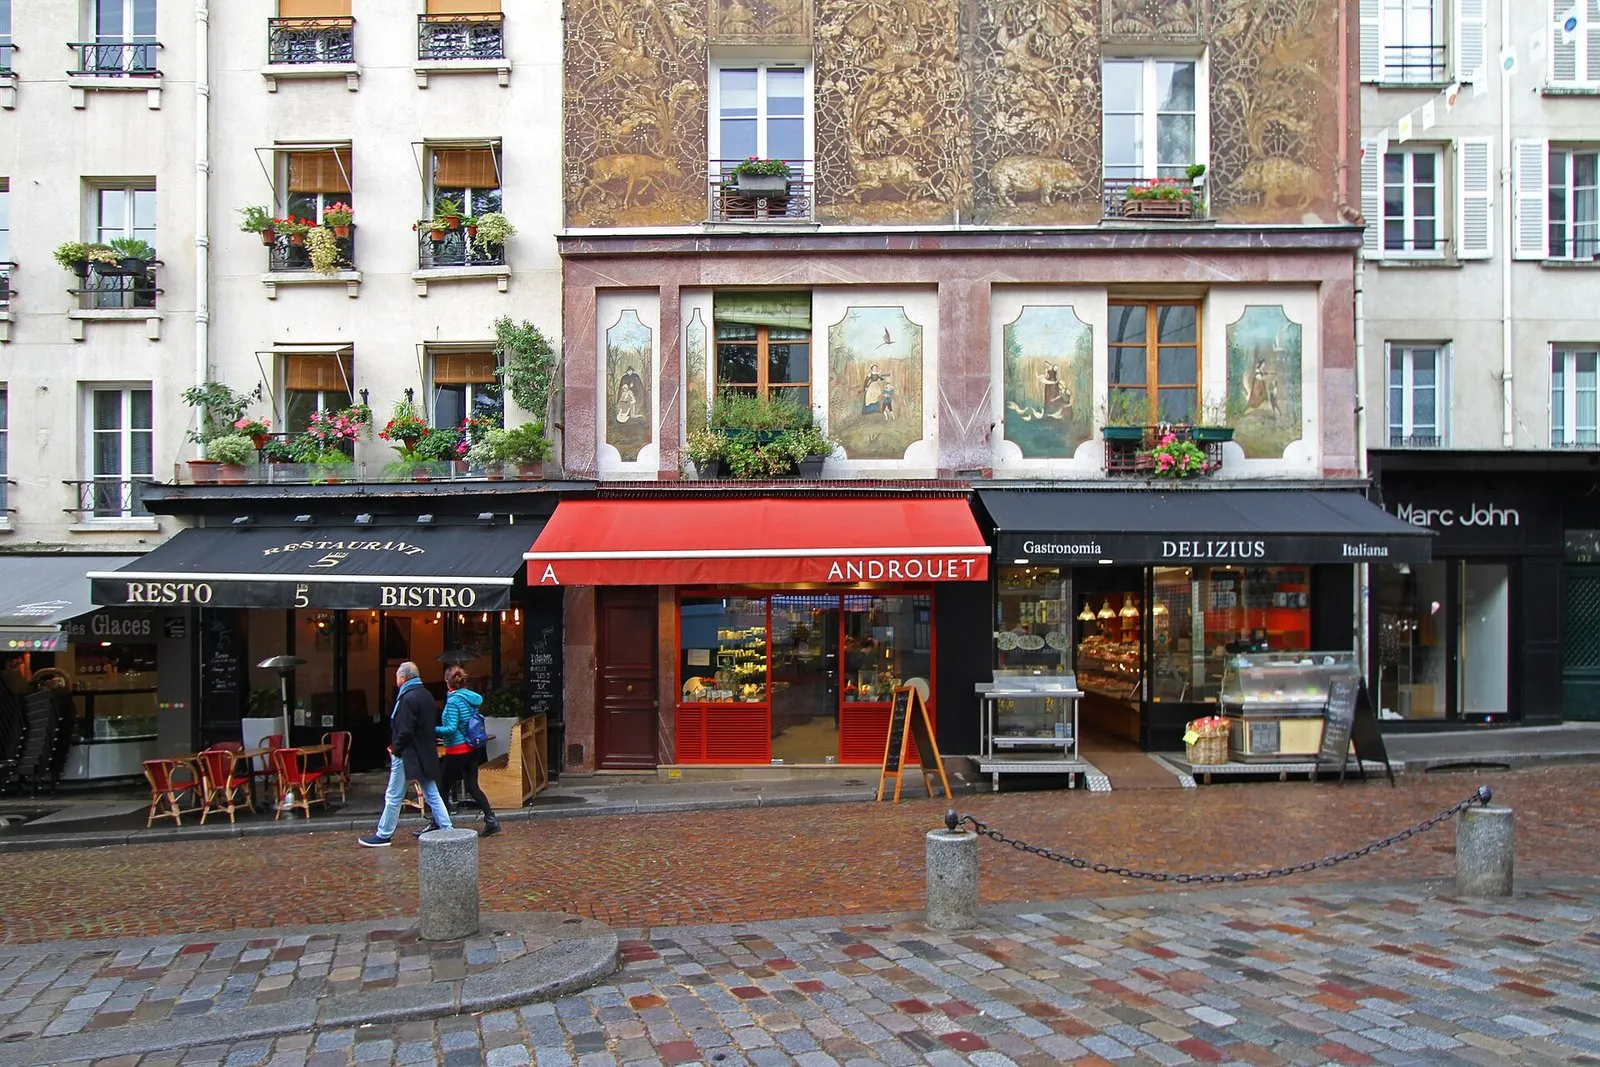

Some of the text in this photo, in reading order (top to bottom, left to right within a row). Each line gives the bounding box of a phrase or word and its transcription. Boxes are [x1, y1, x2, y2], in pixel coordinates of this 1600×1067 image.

[1397, 503, 1519, 526] Marc John
[262, 540, 426, 556] RESTAURANT
[1023, 540, 1102, 555] Gastronomia
[1162, 540, 1265, 558] DELIZIUS
[1342, 543, 1388, 557] Italiana
[308, 555, 346, 568] 5
[827, 558, 976, 581] ANDROUET
[540, 563, 559, 585] A
[126, 582, 213, 604] RESTO
[294, 589, 309, 608] 5
[379, 586, 477, 608] BISTRO
[65, 621, 86, 635] des
[91, 614, 151, 636] Glaces
